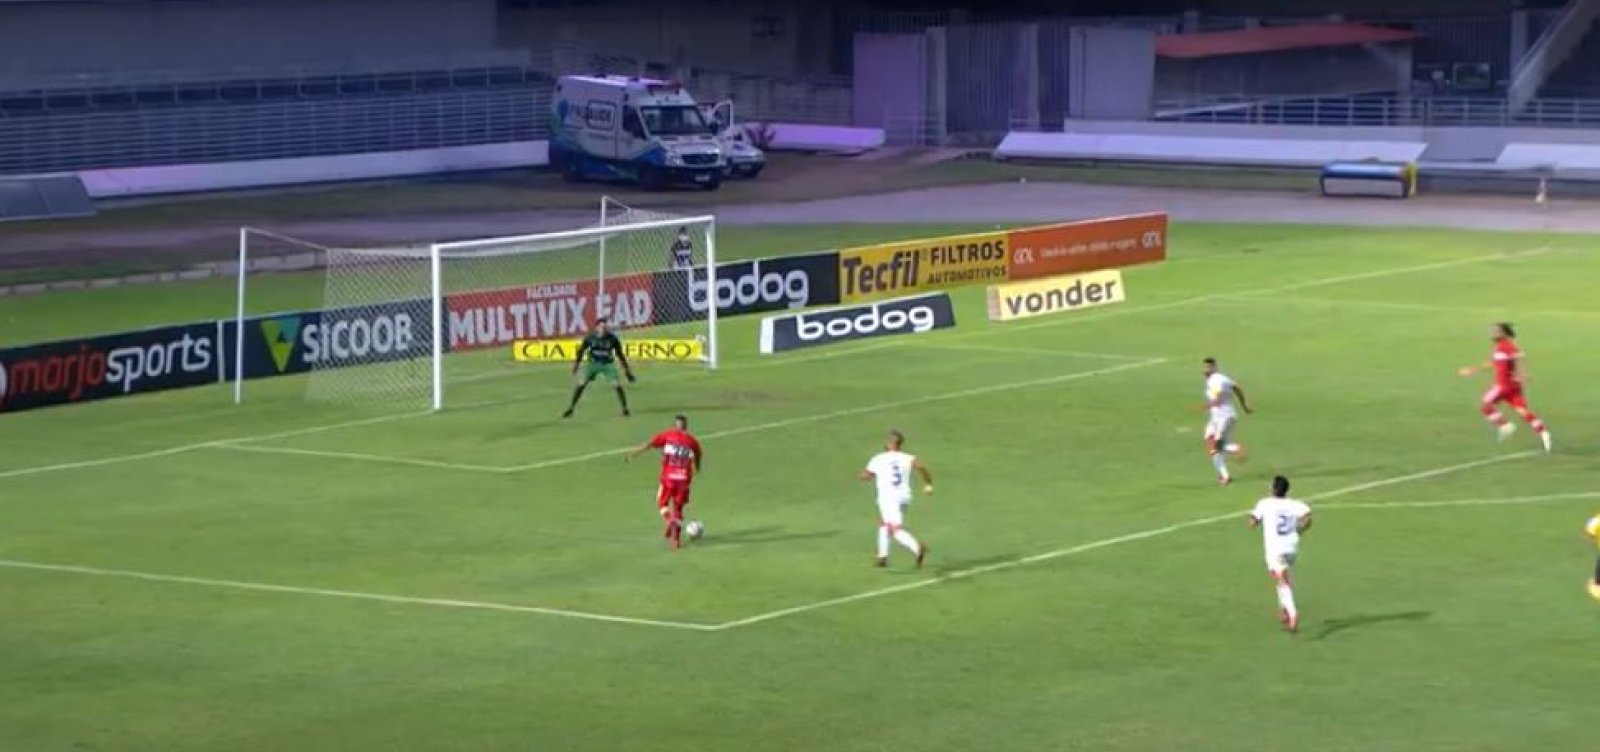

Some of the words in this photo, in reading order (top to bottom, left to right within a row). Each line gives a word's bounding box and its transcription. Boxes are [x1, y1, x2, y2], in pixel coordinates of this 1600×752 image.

[688, 258, 810, 311] bodog
[842, 249, 920, 296] Tecfil
[930, 240, 1005, 266] FILTROS
[928, 265, 1007, 285] AUTOMOTIVOS
[450, 297, 587, 346] MULTIVIX
[596, 289, 651, 329] EAD
[796, 303, 935, 341] bodog
[1006, 278, 1118, 316] vonder
[302, 313, 412, 363] SICOOB
[522, 342, 567, 359] CIA
[624, 340, 693, 358] ERNO
[8, 333, 213, 402] marjosports
